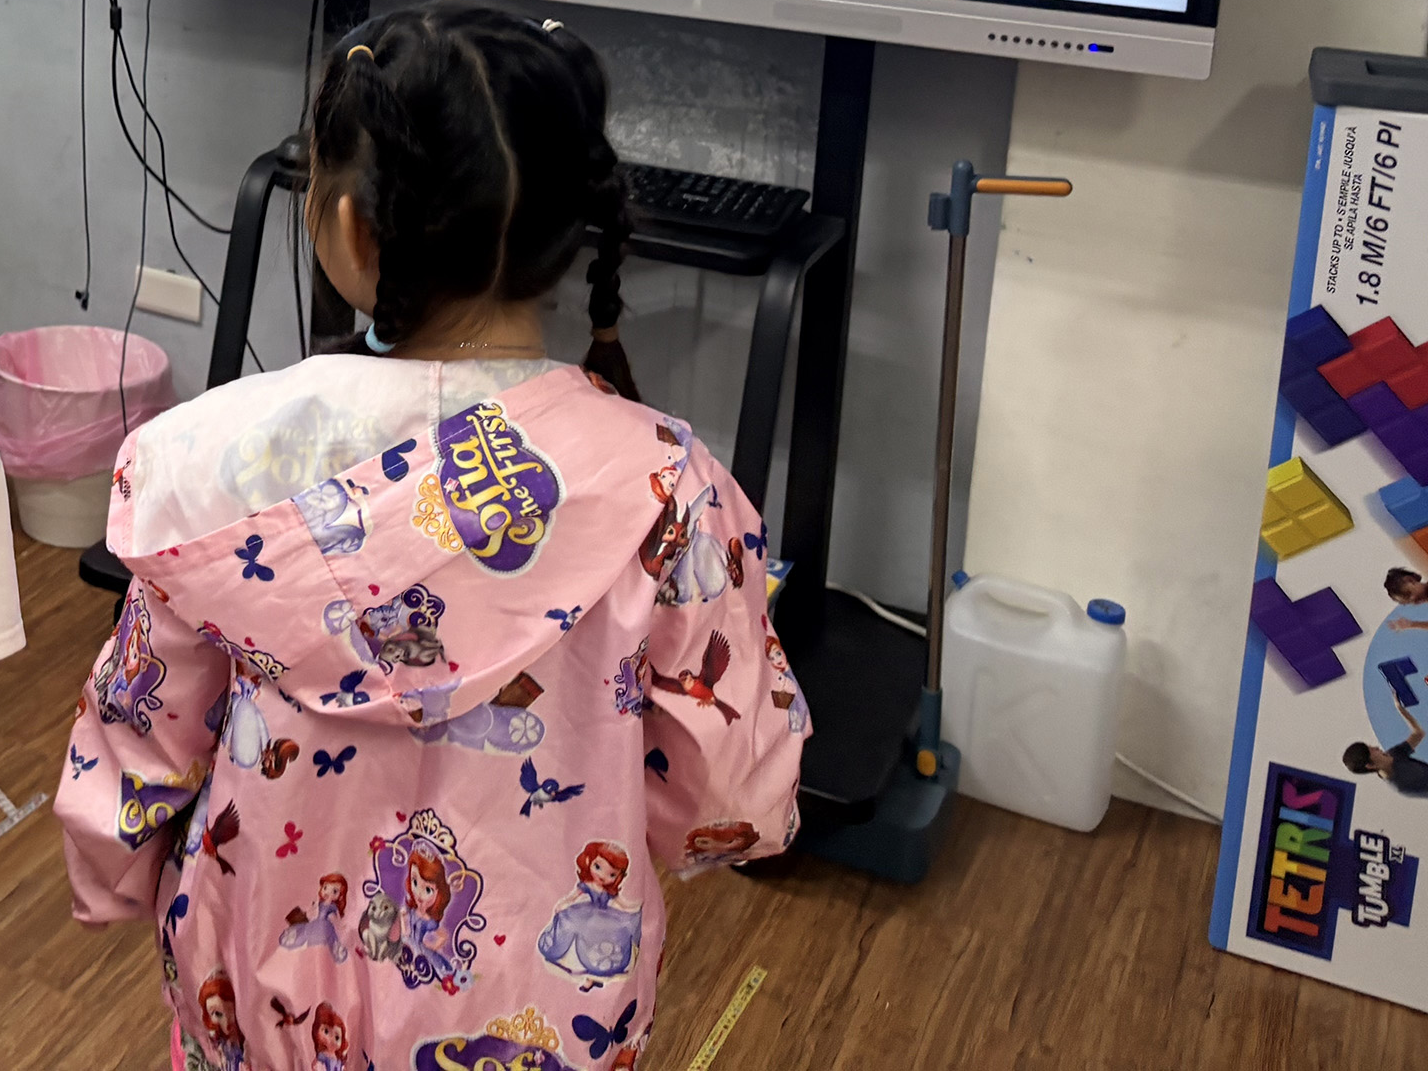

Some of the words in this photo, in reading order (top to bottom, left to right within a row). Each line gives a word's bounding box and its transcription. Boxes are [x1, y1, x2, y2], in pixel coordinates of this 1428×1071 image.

[1350, 173, 1363, 207] HASTA
[1334, 224, 1345, 236] TO
[1345, 207, 1360, 237] APILA
[1356, 270, 1382, 306] 1.8
[1377, 120, 1402, 149] PI
[1332, 236, 1343, 254] UP
[1343, 237, 1355, 251] SE
[1326, 255, 1341, 294] STACKS
[465, 402, 544, 489] First
[449, 436, 545, 558] Sofia
[1263, 779, 1338, 937] TETRIS
[1357, 833, 1390, 925] TUMBLE
